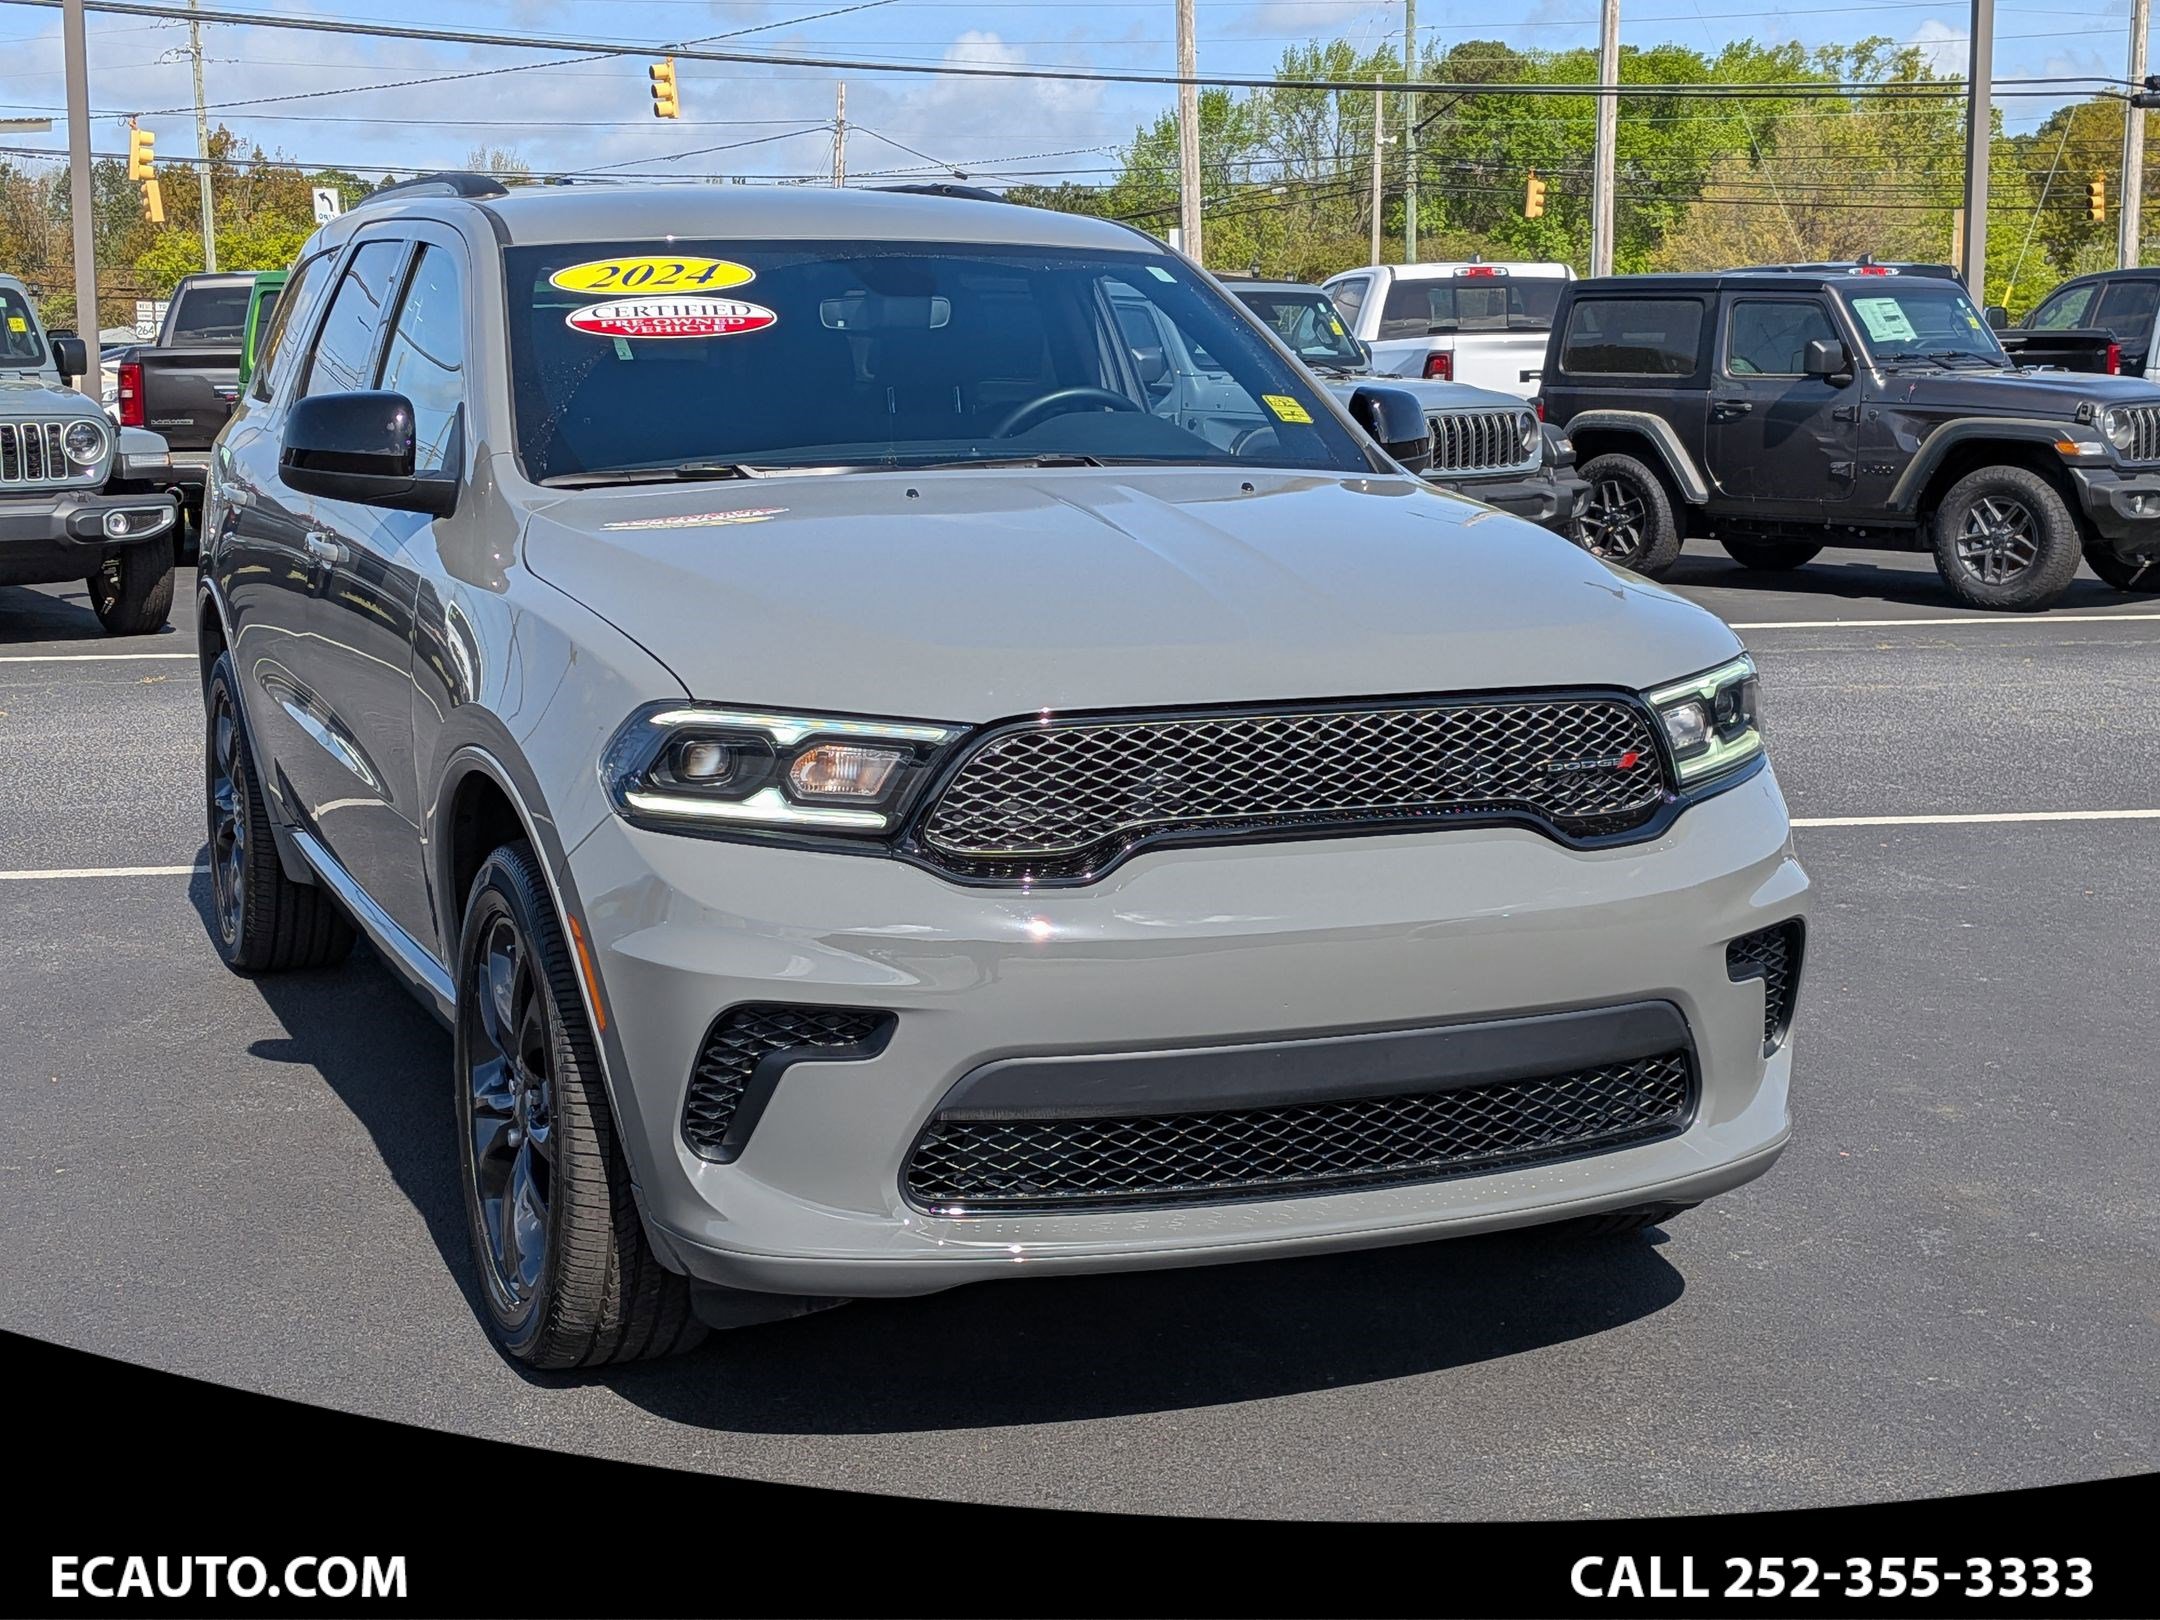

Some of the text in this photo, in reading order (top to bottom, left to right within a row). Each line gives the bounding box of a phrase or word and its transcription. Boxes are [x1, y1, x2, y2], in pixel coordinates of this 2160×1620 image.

[586, 263, 720, 288] 2024
[592, 304, 750, 318] CERTIFIED
[601, 317, 746, 328] PRE-OWNED
[624, 324, 726, 333] VEHICLE
[137, 325, 154, 336] 264
[1548, 758, 1620, 771] DODGE
